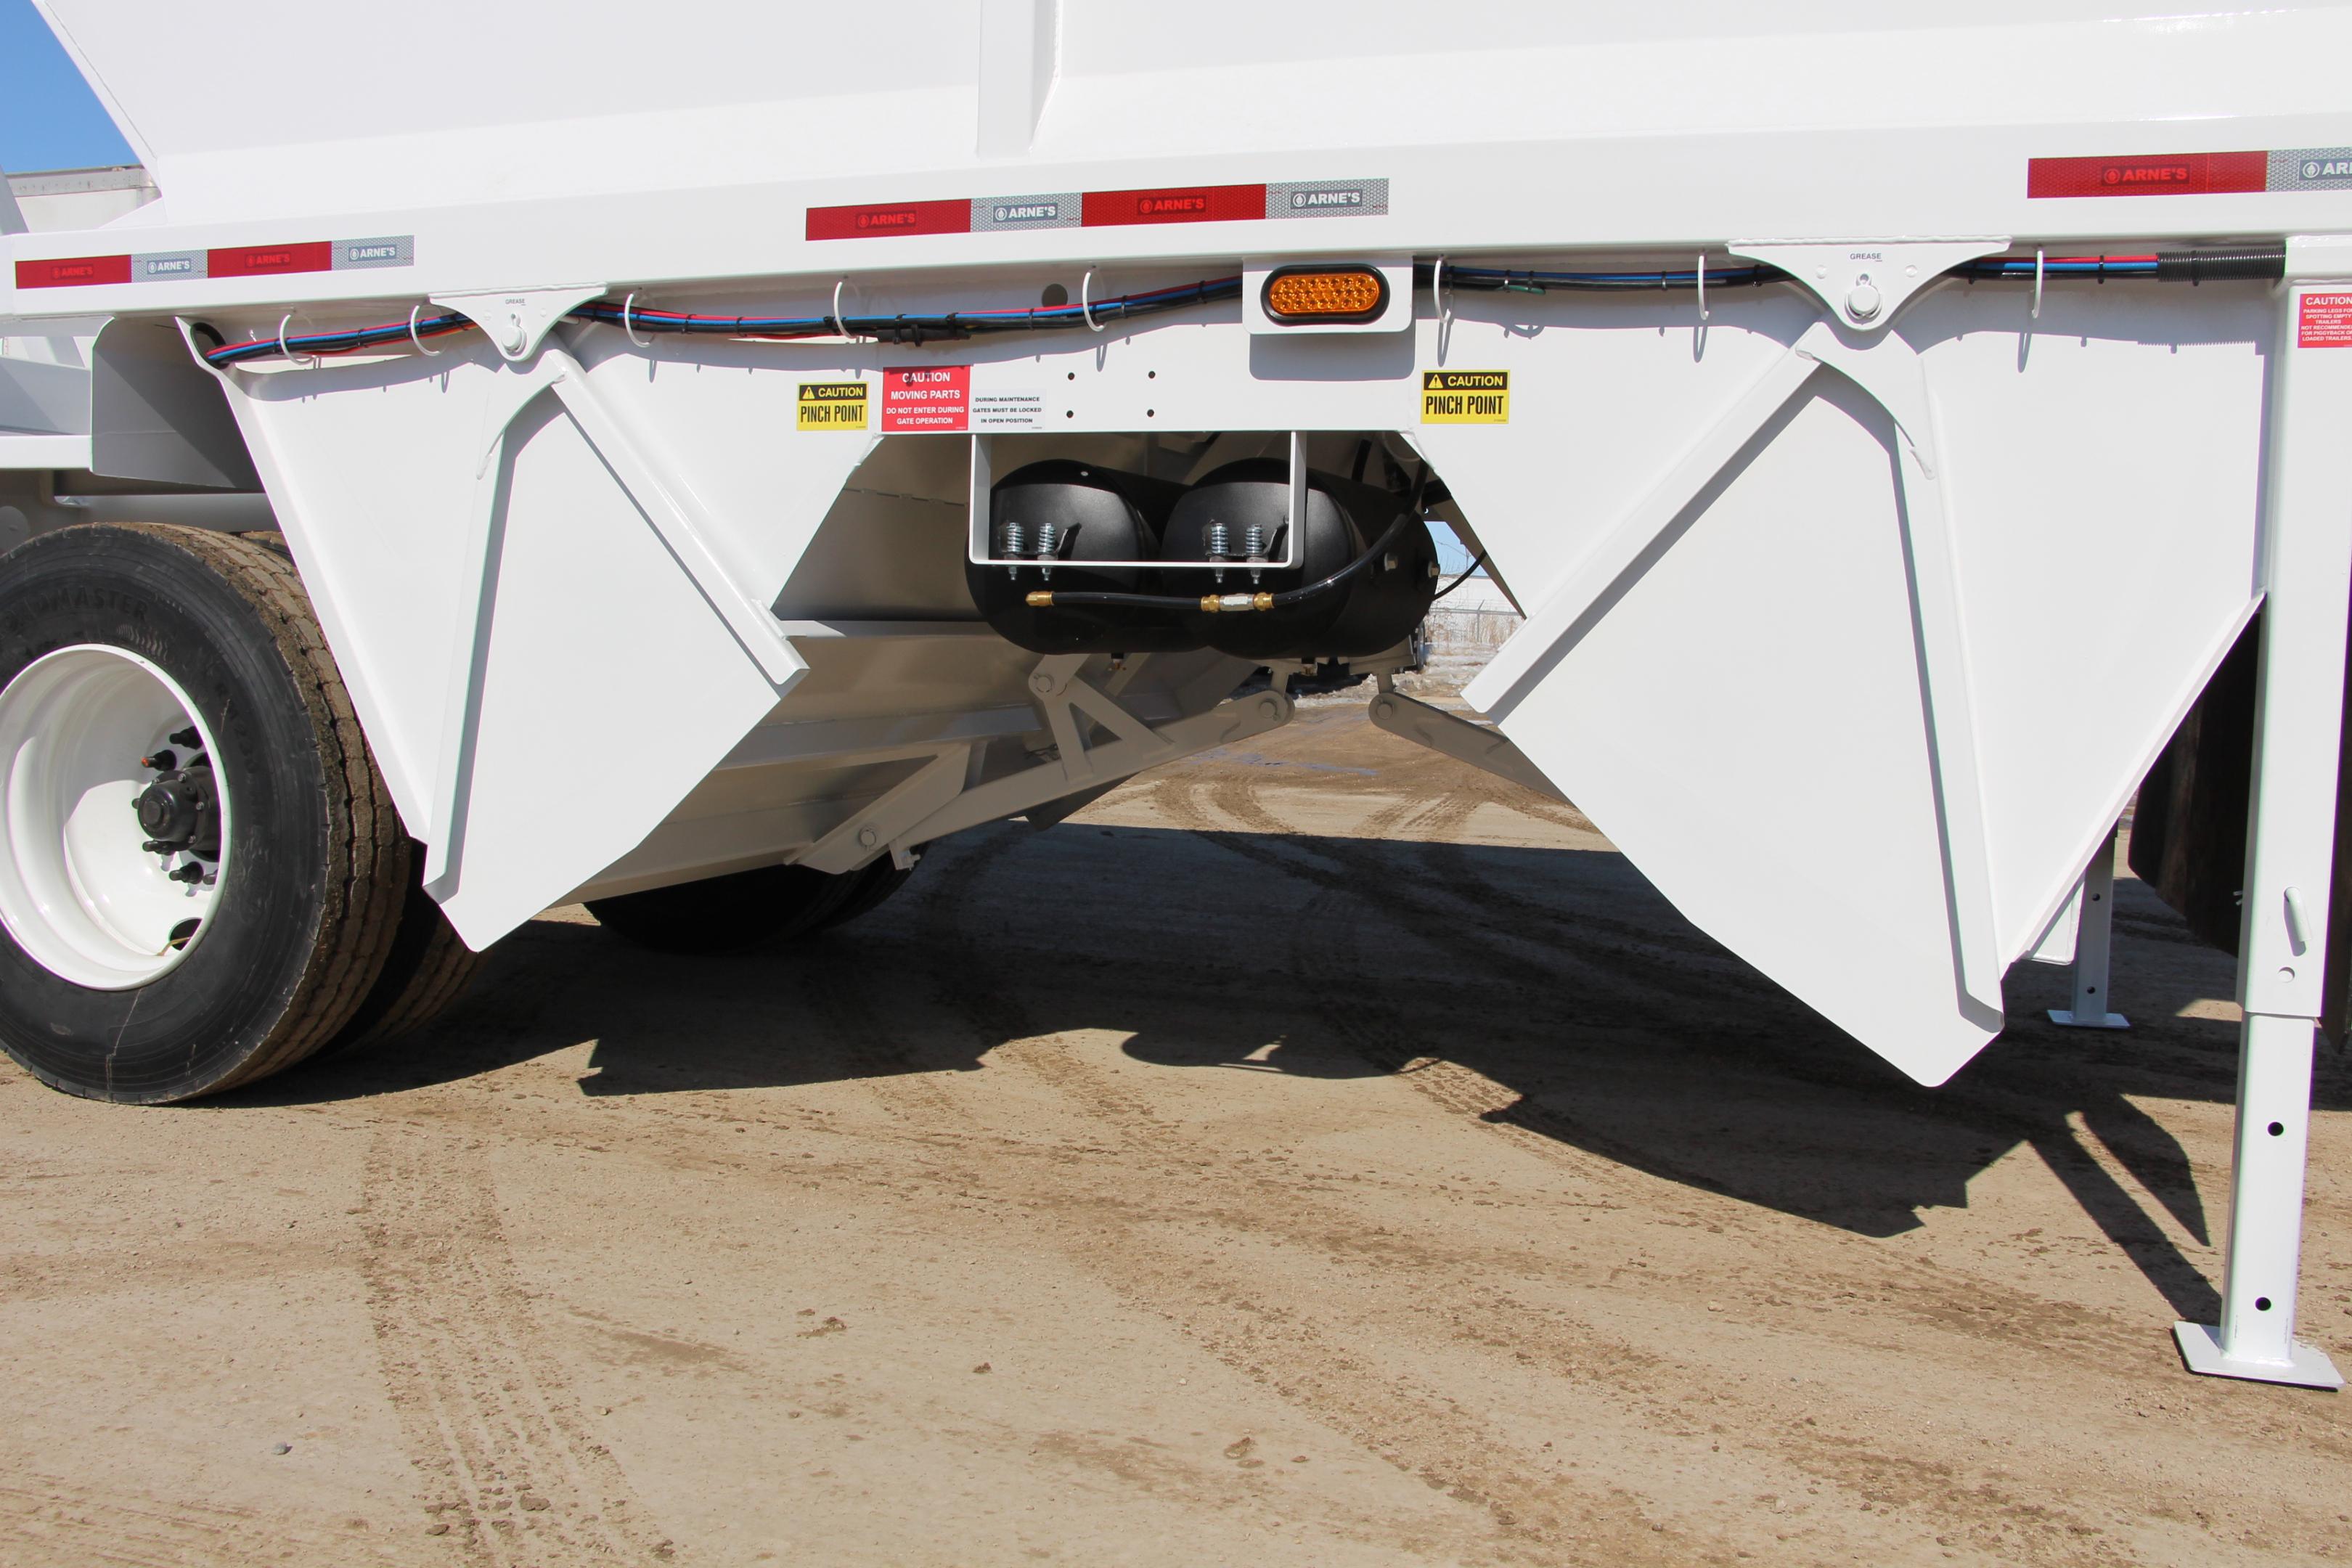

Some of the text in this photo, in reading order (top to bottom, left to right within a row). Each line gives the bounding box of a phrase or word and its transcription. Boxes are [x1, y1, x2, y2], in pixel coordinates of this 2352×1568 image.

[2121, 167, 2188, 181] ARNE'S
[1307, 191, 1361, 205] ARNE'S
[1153, 198, 1205, 211] ARNE'S
[1008, 205, 1056, 219] ARNE'S
[870, 213, 916, 226] ARNE'S
[359, 247, 396, 258] ARNE'S
[157, 261, 191, 271] ARNE'S
[256, 254, 290, 266] ARNE'S
[61, 266, 94, 277] ARNE'S
[902, 372, 950, 383] CAUTION
[1447, 375, 1503, 386] CAUTION
[818, 387, 863, 397] CAUTION
[891, 390, 960, 400] MOVING PARTS
[1426, 396, 1504, 415] PINCH POINT
[801, 405, 864, 422] PINCH POINT
